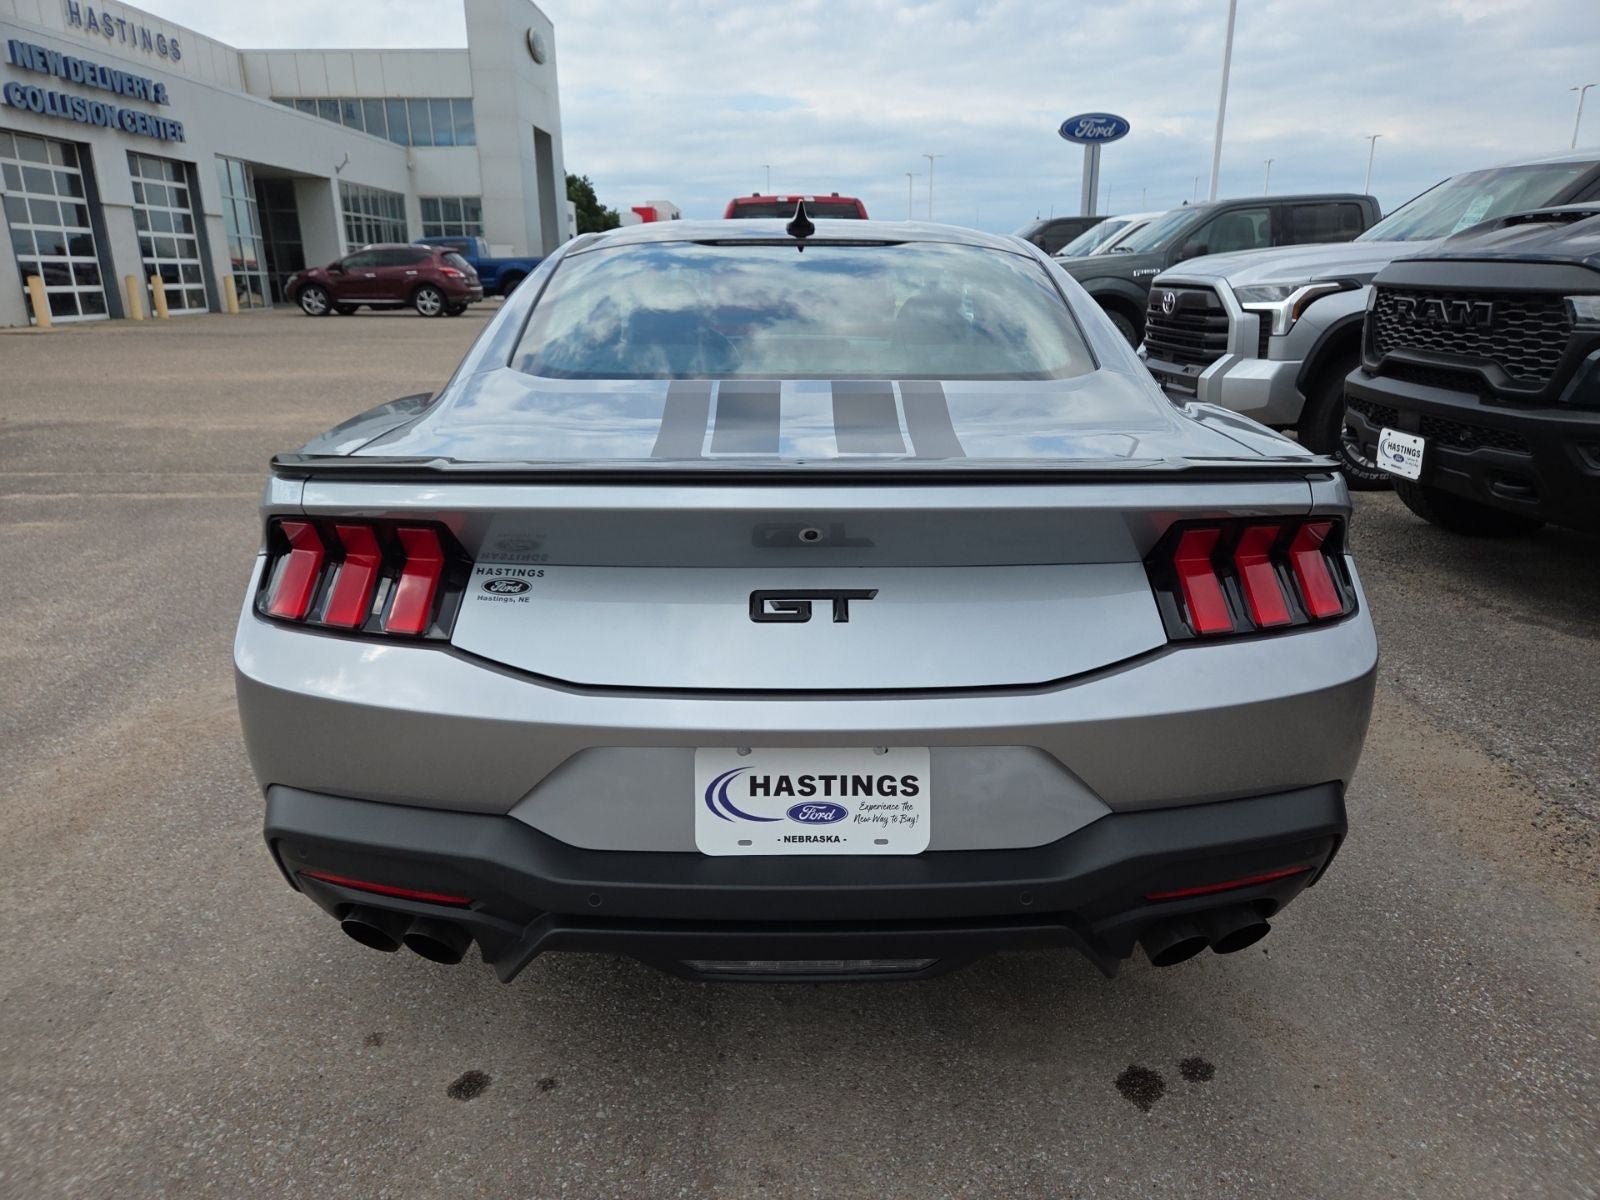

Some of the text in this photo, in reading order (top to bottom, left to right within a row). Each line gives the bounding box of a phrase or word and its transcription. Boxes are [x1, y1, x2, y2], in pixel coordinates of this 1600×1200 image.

[67, 0, 181, 61] HASTINGS
[8, 39, 170, 106] NEW DELIVERY &
[4, 82, 186, 143] COLLISION CENTER
[1075, 118, 1117, 138] Ford
[1393, 296, 1493, 326] RAM
[1387, 441, 1421, 458] HASTINGS
[476, 567, 545, 577] HASTINGS
[490, 580, 523, 592] Ford
[477, 595, 516, 603] Hastings,
[749, 589, 879, 623] GT
[750, 775, 920, 797] HASTINGS
[799, 805, 836, 821] Ford
[859, 801, 900, 813] Experience
[853, 813, 872, 825] New
[872, 812, 889, 830] Way
[784, 835, 841, 843] NEBRASKA
